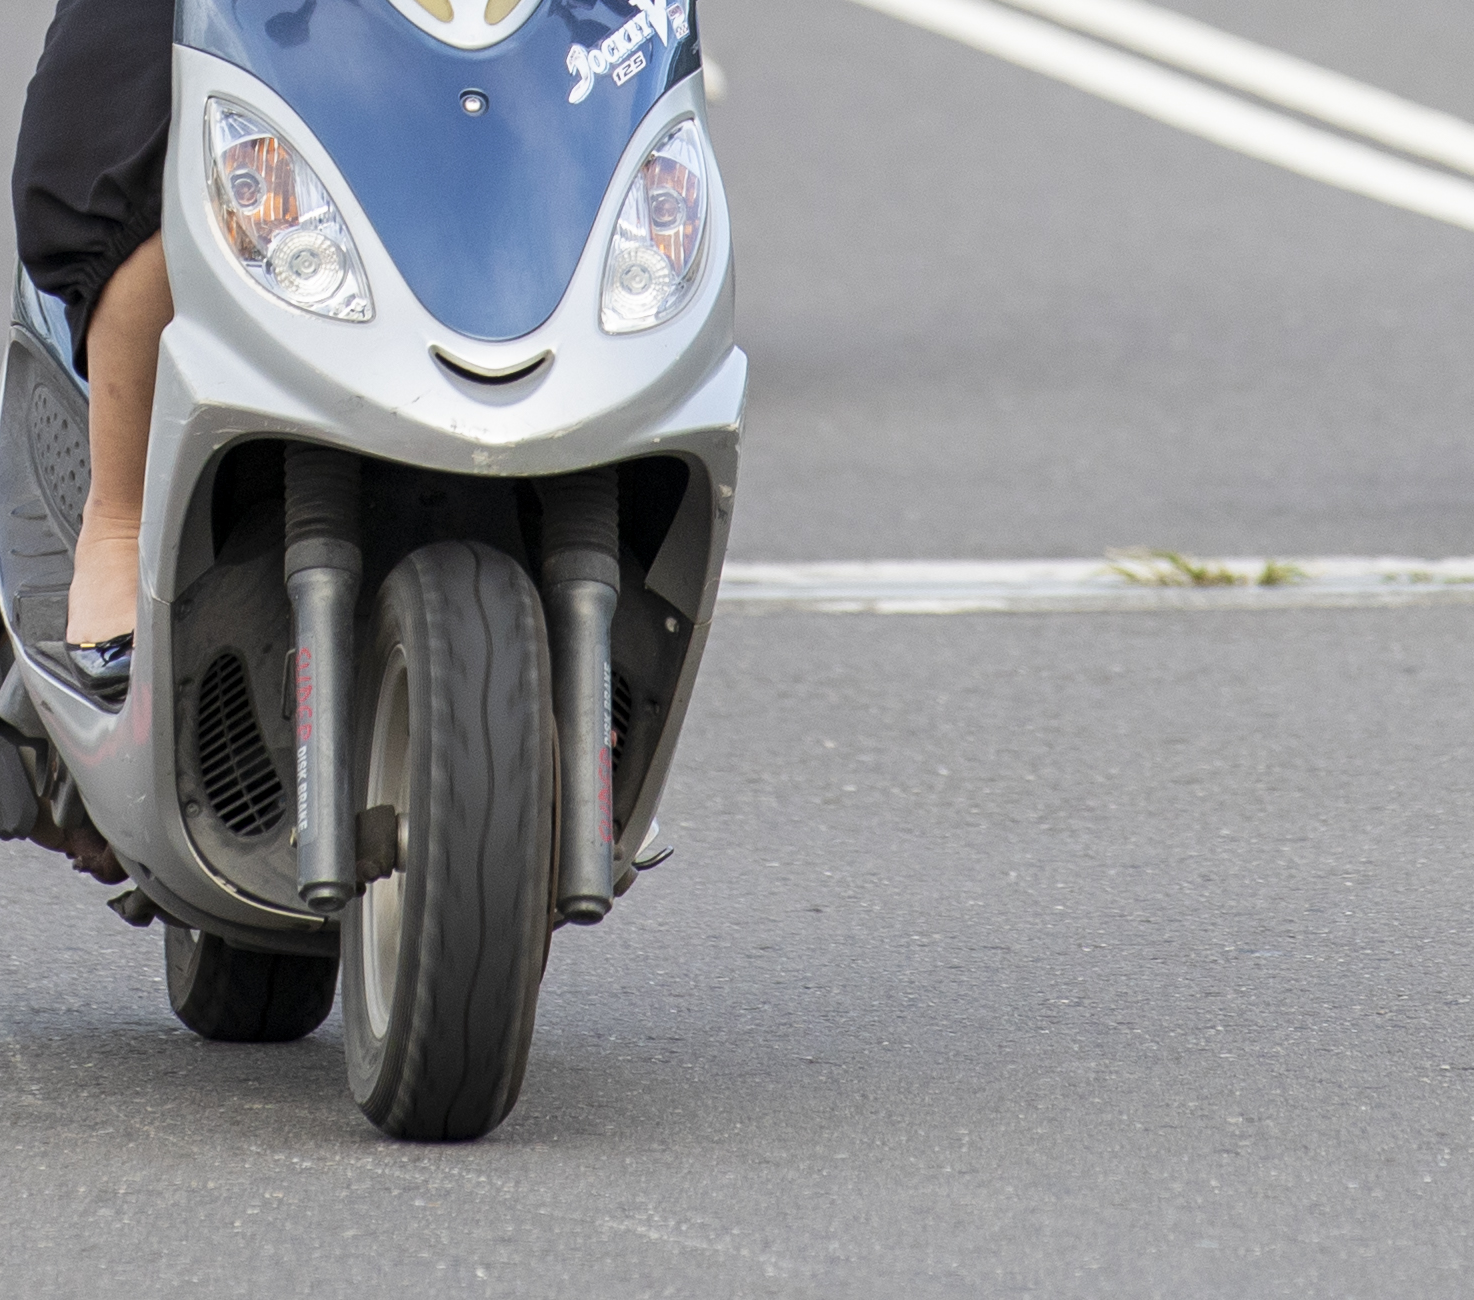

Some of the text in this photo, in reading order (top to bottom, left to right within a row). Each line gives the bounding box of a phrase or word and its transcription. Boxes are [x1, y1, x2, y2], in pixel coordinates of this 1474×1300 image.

[612, 51, 647, 87] 125
[297, 745, 307, 780] DISK
[297, 781, 308, 832] BRAKE
